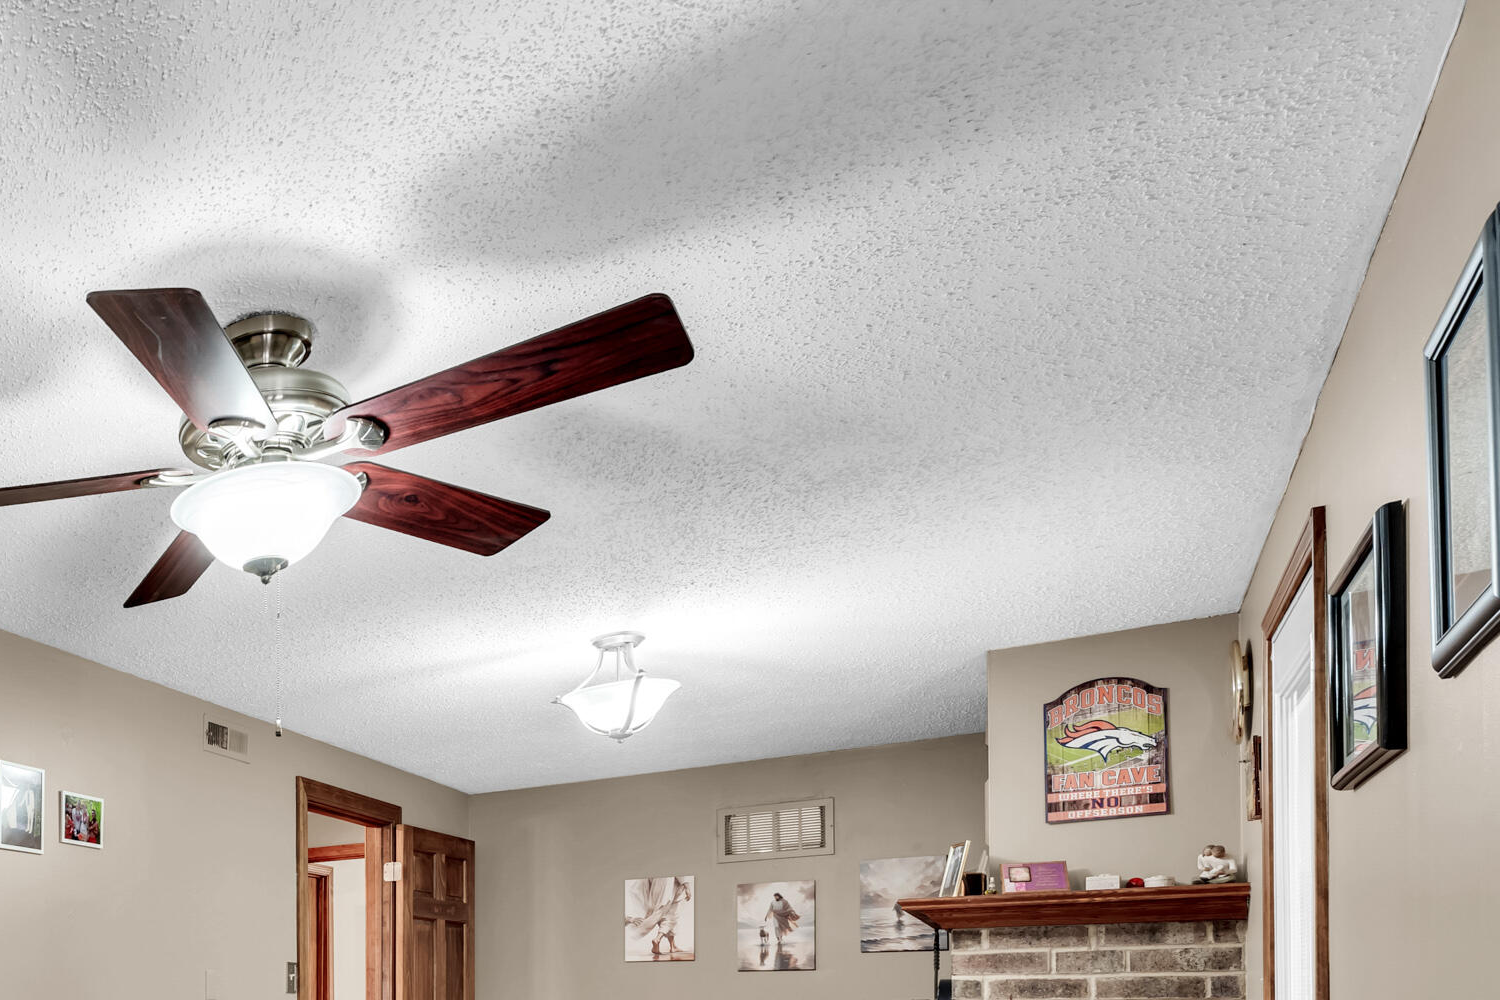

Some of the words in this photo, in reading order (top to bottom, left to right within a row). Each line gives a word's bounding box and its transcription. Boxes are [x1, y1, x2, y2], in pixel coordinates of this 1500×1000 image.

[1047, 684, 1163, 728] BRONCOS
[1052, 773, 1095, 792] FAN
[1102, 765, 1161, 787] CAVE
[1058, 790, 1100, 800] WHERE
[1103, 785, 1153, 797] THERE'S
[1091, 797, 1120, 809] NO
[1068, 806, 1144, 819] OFFSEASON
